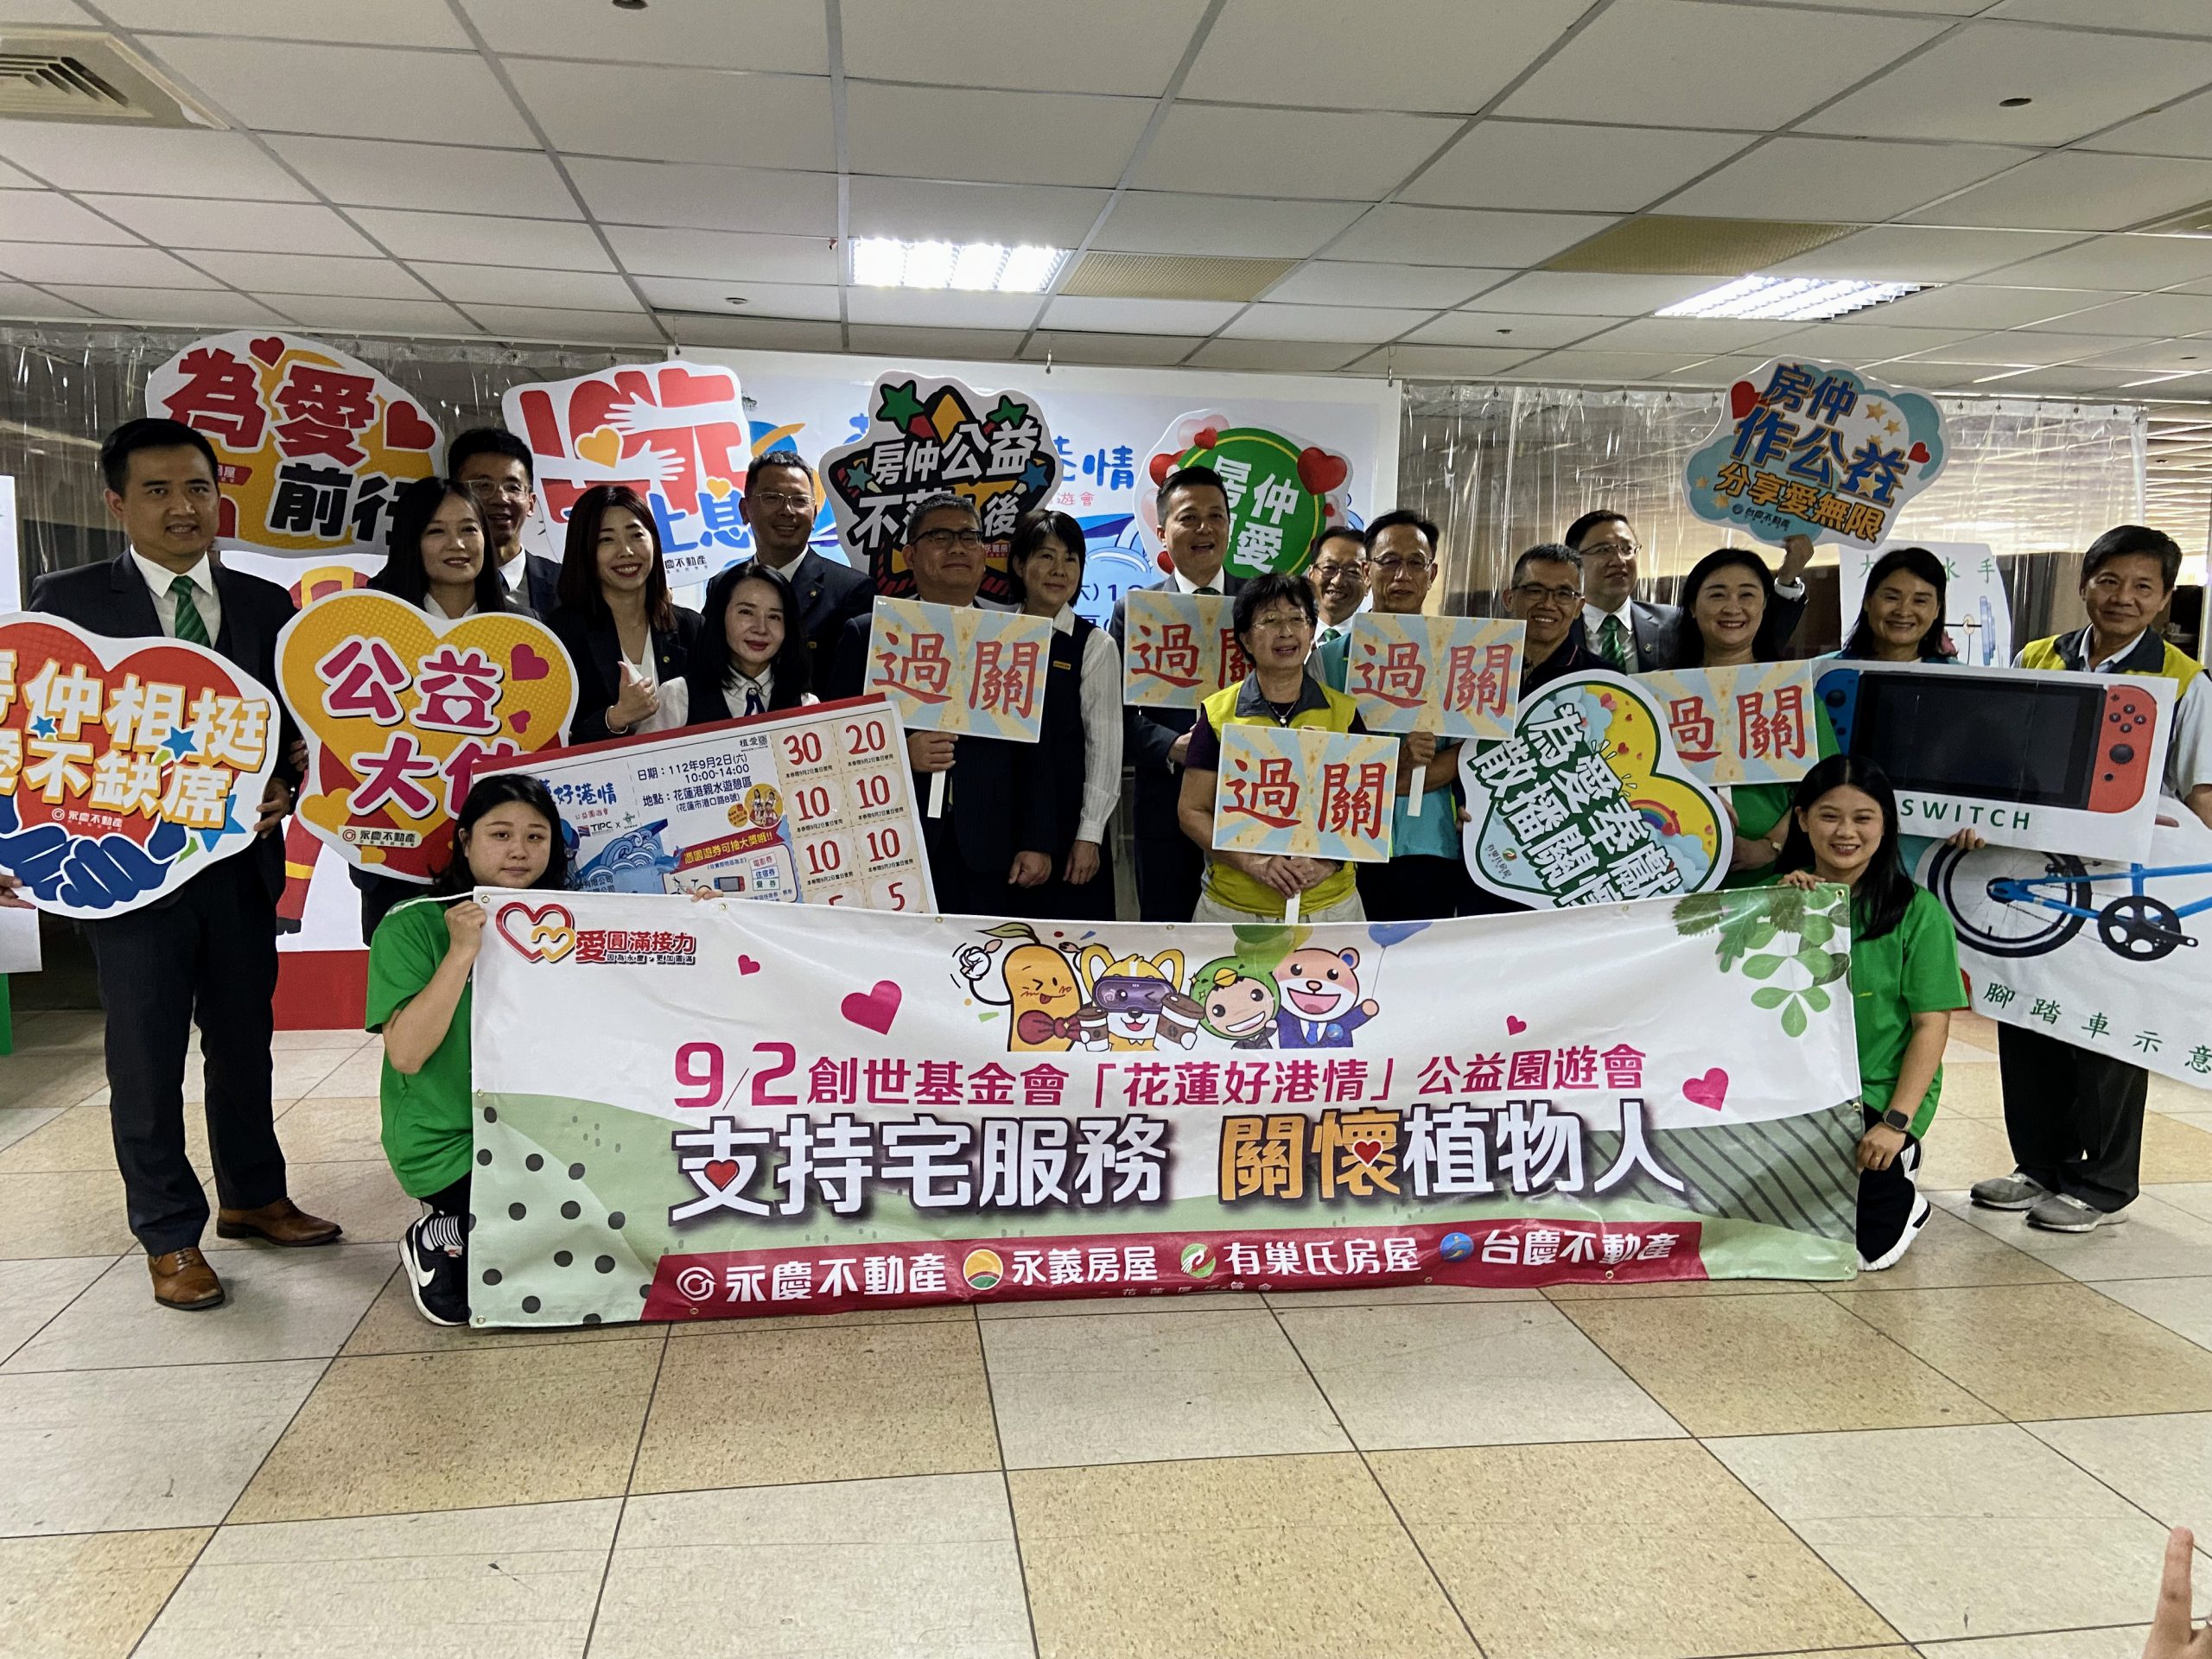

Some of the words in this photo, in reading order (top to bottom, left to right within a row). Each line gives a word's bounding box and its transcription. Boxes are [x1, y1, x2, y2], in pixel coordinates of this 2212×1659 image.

[162, 347, 375, 467] 為愛
[1763, 363, 1857, 424] 房仲
[871, 418, 1039, 486] 房仲公益
[1731, 405, 1908, 507] 作公益
[1049, 492, 1095, 506] 遊會
[1213, 455, 1300, 524] 房仲
[1714, 462, 1885, 543] 分享愛無限
[853, 487, 1021, 549] 不後
[1227, 512, 1284, 575] 愛
[1859, 554, 1996, 583] 大水手
[321, 641, 499, 728] 公益
[873, 632, 1039, 720] 過關
[1351, 642, 1515, 717] 過關
[845, 720, 887, 755] 20
[1669, 684, 1807, 763] 過關
[685, 763, 751, 784] 10:00-14:00
[783, 732, 823, 766] 30
[795, 786, 830, 822] 10
[856, 774, 891, 810] 10
[1222, 758, 1389, 840] 過關
[1526, 701, 1684, 899] 為愛奉獻
[1901, 798, 2031, 830] SWITCH
[590, 821, 613, 832] TIPC
[867, 828, 901, 862] 10
[806, 840, 842, 875] 10
[887, 881, 906, 912] 5
[575, 931, 696, 963] 愛圓滿接力
[674, 1042, 1647, 1109] 9/2創世基金會「花蓮好港情」公益園遊會
[669, 1114, 1170, 1222] 支持宅服務
[1217, 1099, 1687, 1203] 關懷植物人
[1011, 1245, 1159, 1287] 永義房屋
[1223, 1237, 1421, 1277] 有巢氏房屋
[1481, 1230, 1681, 1267] 台慶不動產
[724, 1253, 948, 1303] 永慶不動產
